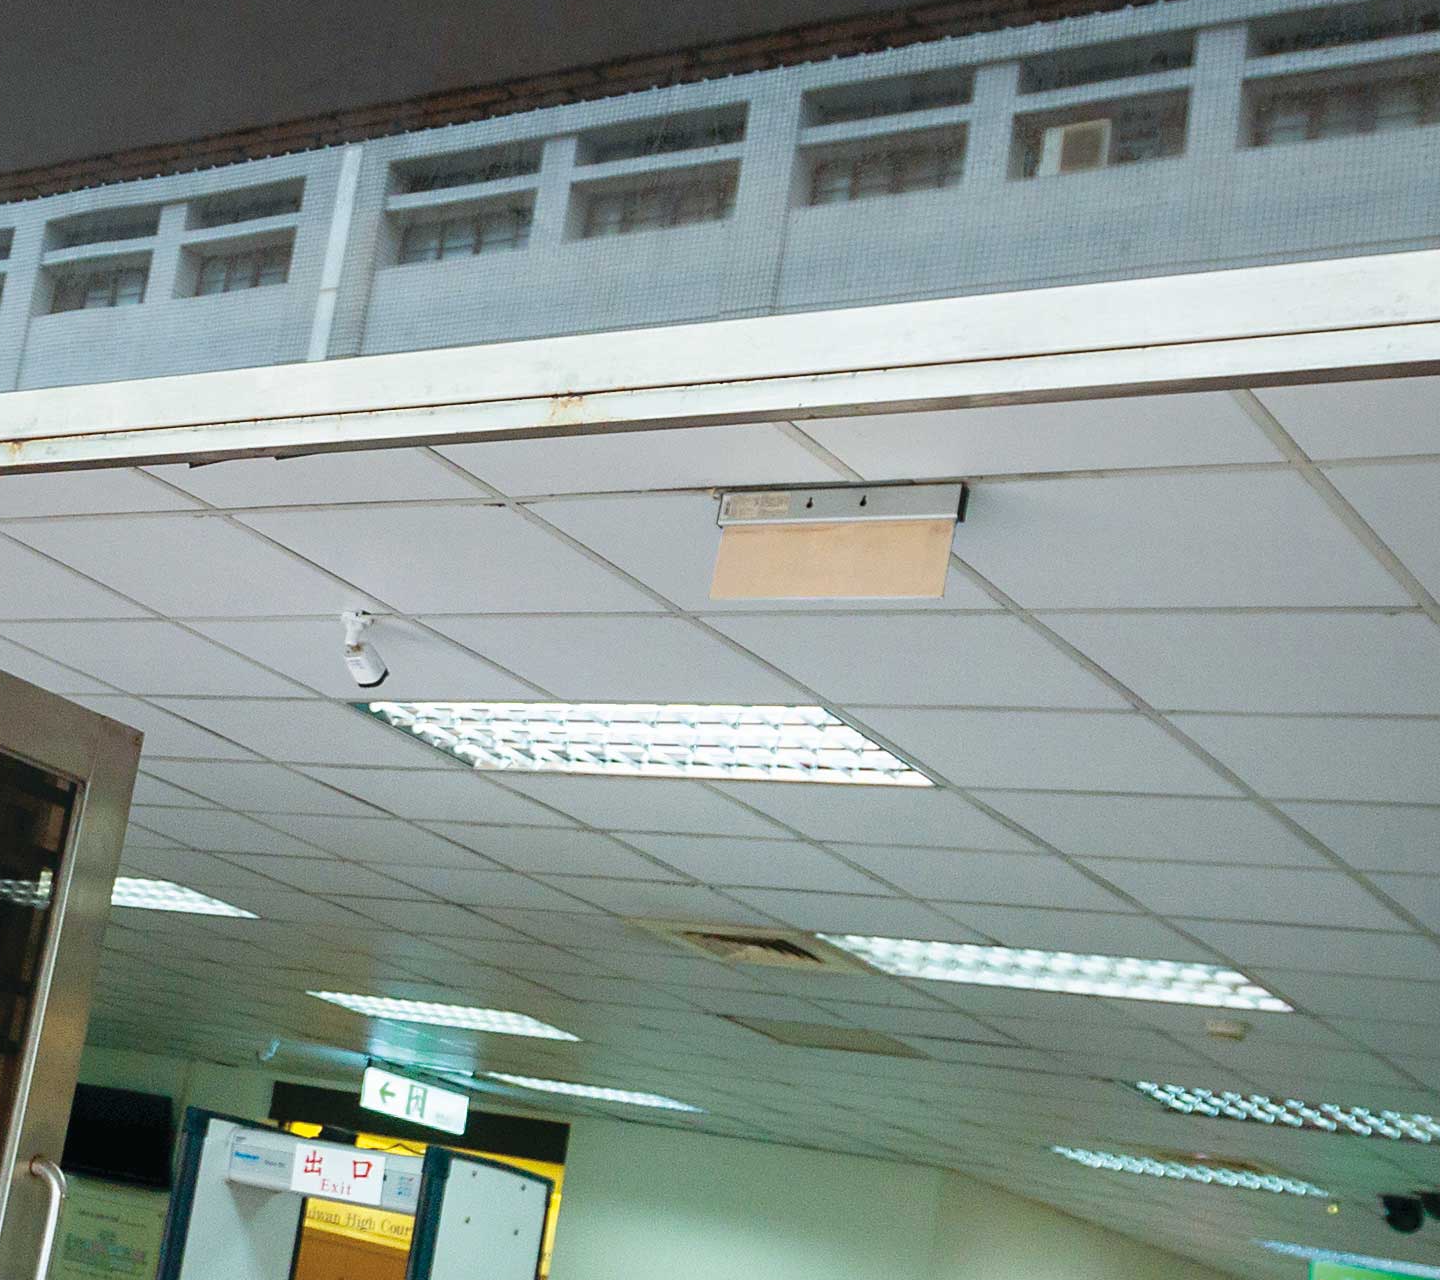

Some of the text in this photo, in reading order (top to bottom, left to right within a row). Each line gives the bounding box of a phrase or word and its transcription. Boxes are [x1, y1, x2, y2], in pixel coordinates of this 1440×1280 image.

[304, 1150, 373, 1179] 出口
[320, 1179, 353, 1196] Exit
[380, 1216, 412, 1237] Cour
